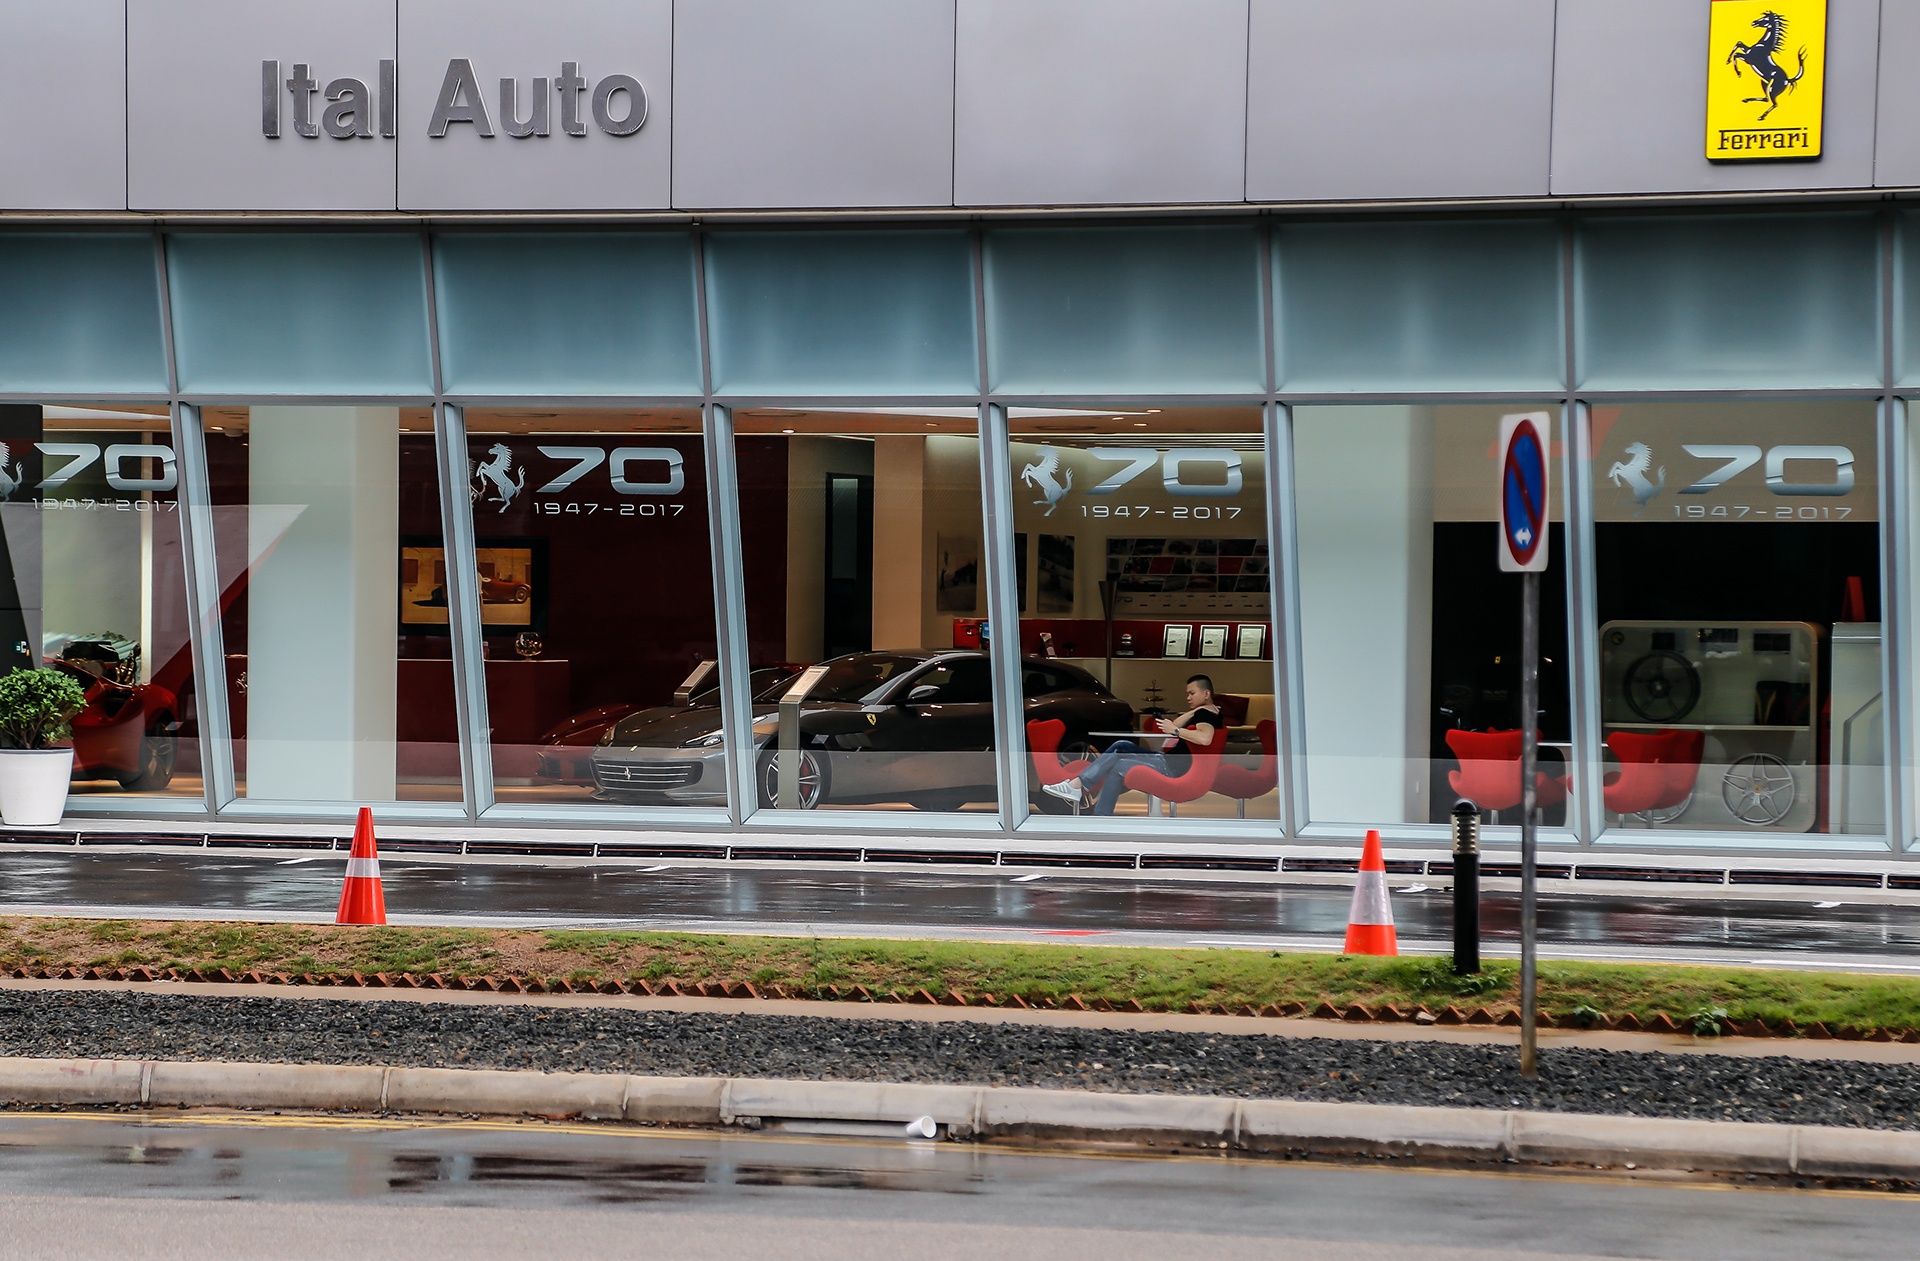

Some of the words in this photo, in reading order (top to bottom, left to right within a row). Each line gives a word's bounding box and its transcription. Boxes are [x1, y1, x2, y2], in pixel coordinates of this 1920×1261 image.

[261, 58, 396, 139] Ital
[425, 57, 649, 139] Auto
[1717, 127, 1809, 150] Ferrari
[33, 442, 178, 491] 70
[536, 446, 685, 495] 70
[1085, 447, 1243, 497] 70
[1677, 444, 1855, 497] 70
[32, 497, 178, 512] 1947-2017
[534, 502, 685, 516] 1947-2017
[1081, 505, 1242, 520] 1947-2017
[1674, 505, 1853, 519] 1947-2017
